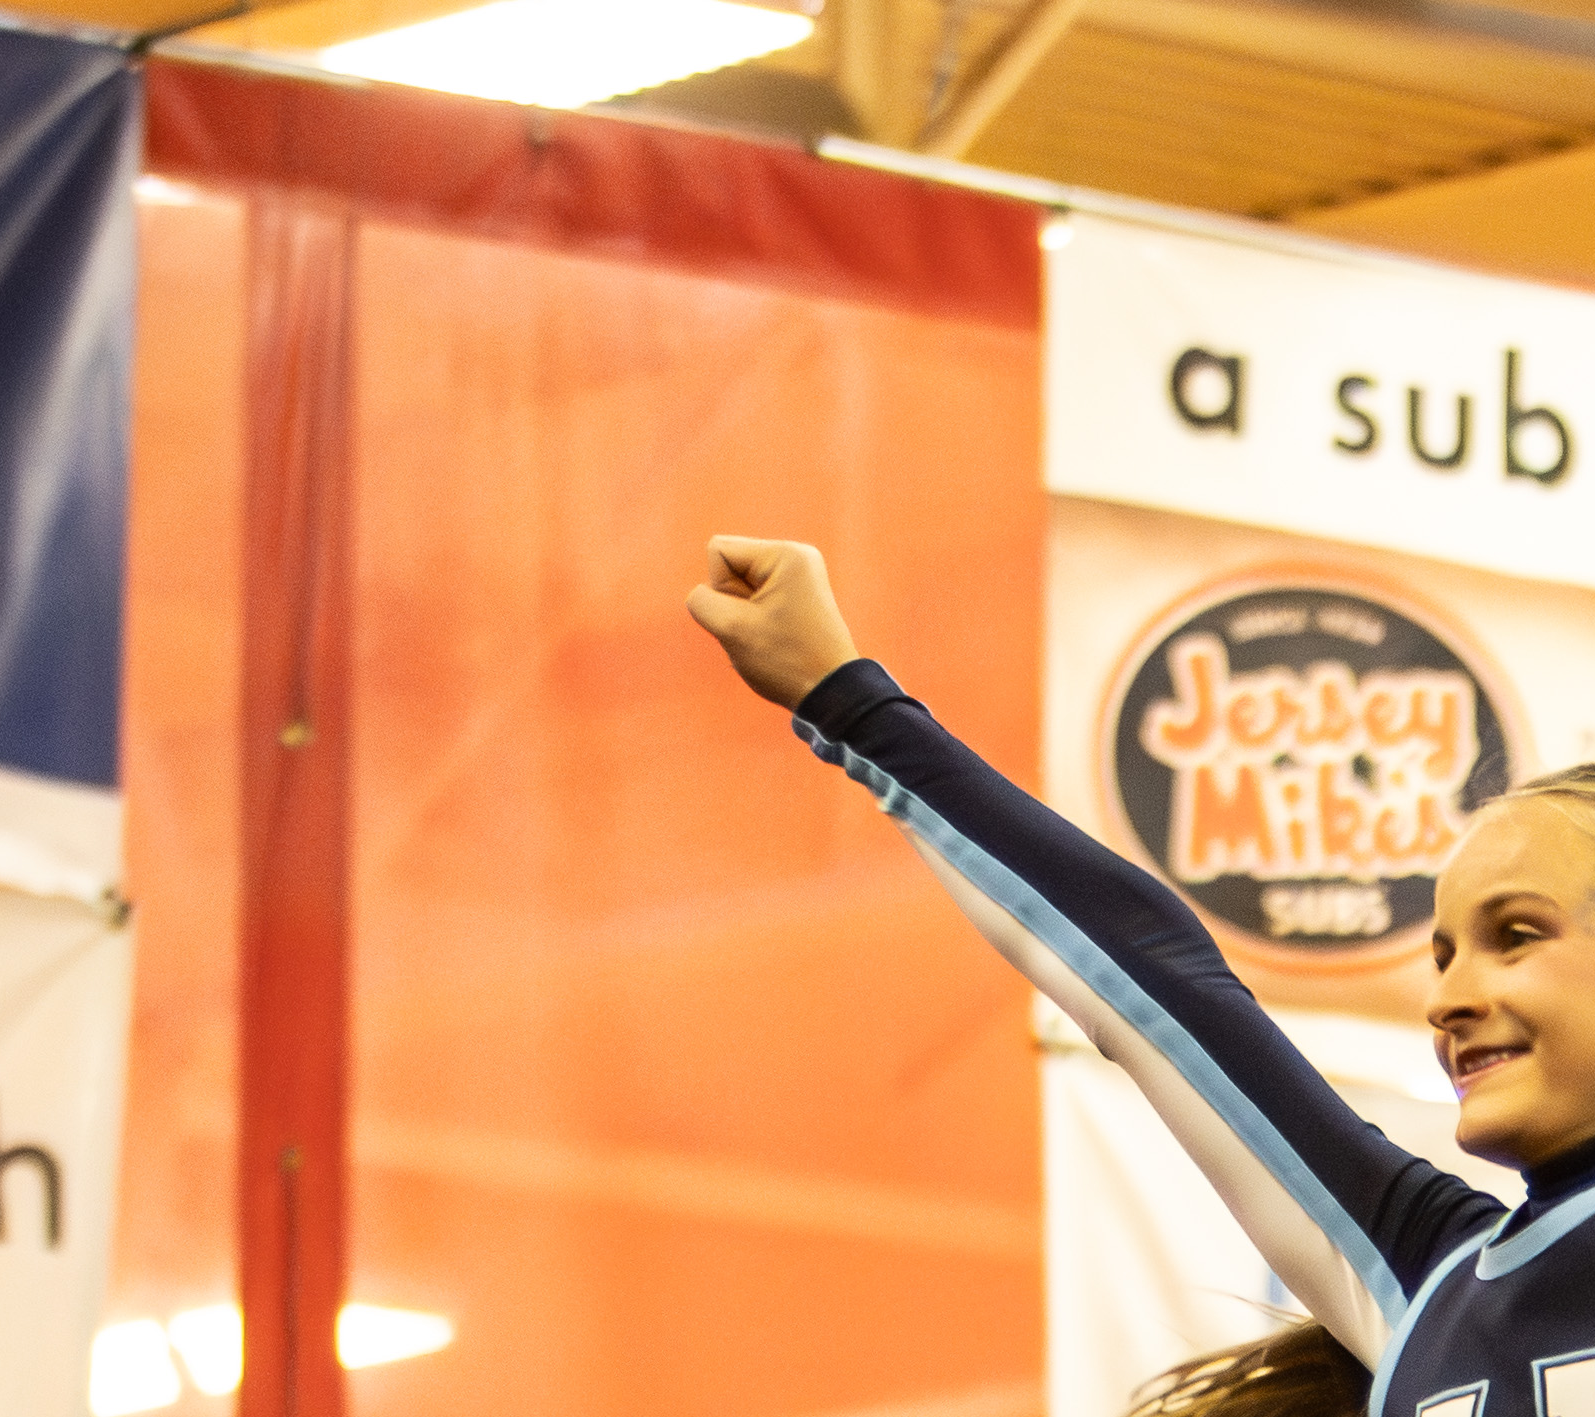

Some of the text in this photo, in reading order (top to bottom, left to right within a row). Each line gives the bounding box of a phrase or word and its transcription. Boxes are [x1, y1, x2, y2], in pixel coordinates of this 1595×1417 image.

[1168, 342, 1250, 437] a
[1329, 346, 1577, 487] sub
[1142, 632, 1479, 788] Jersey
